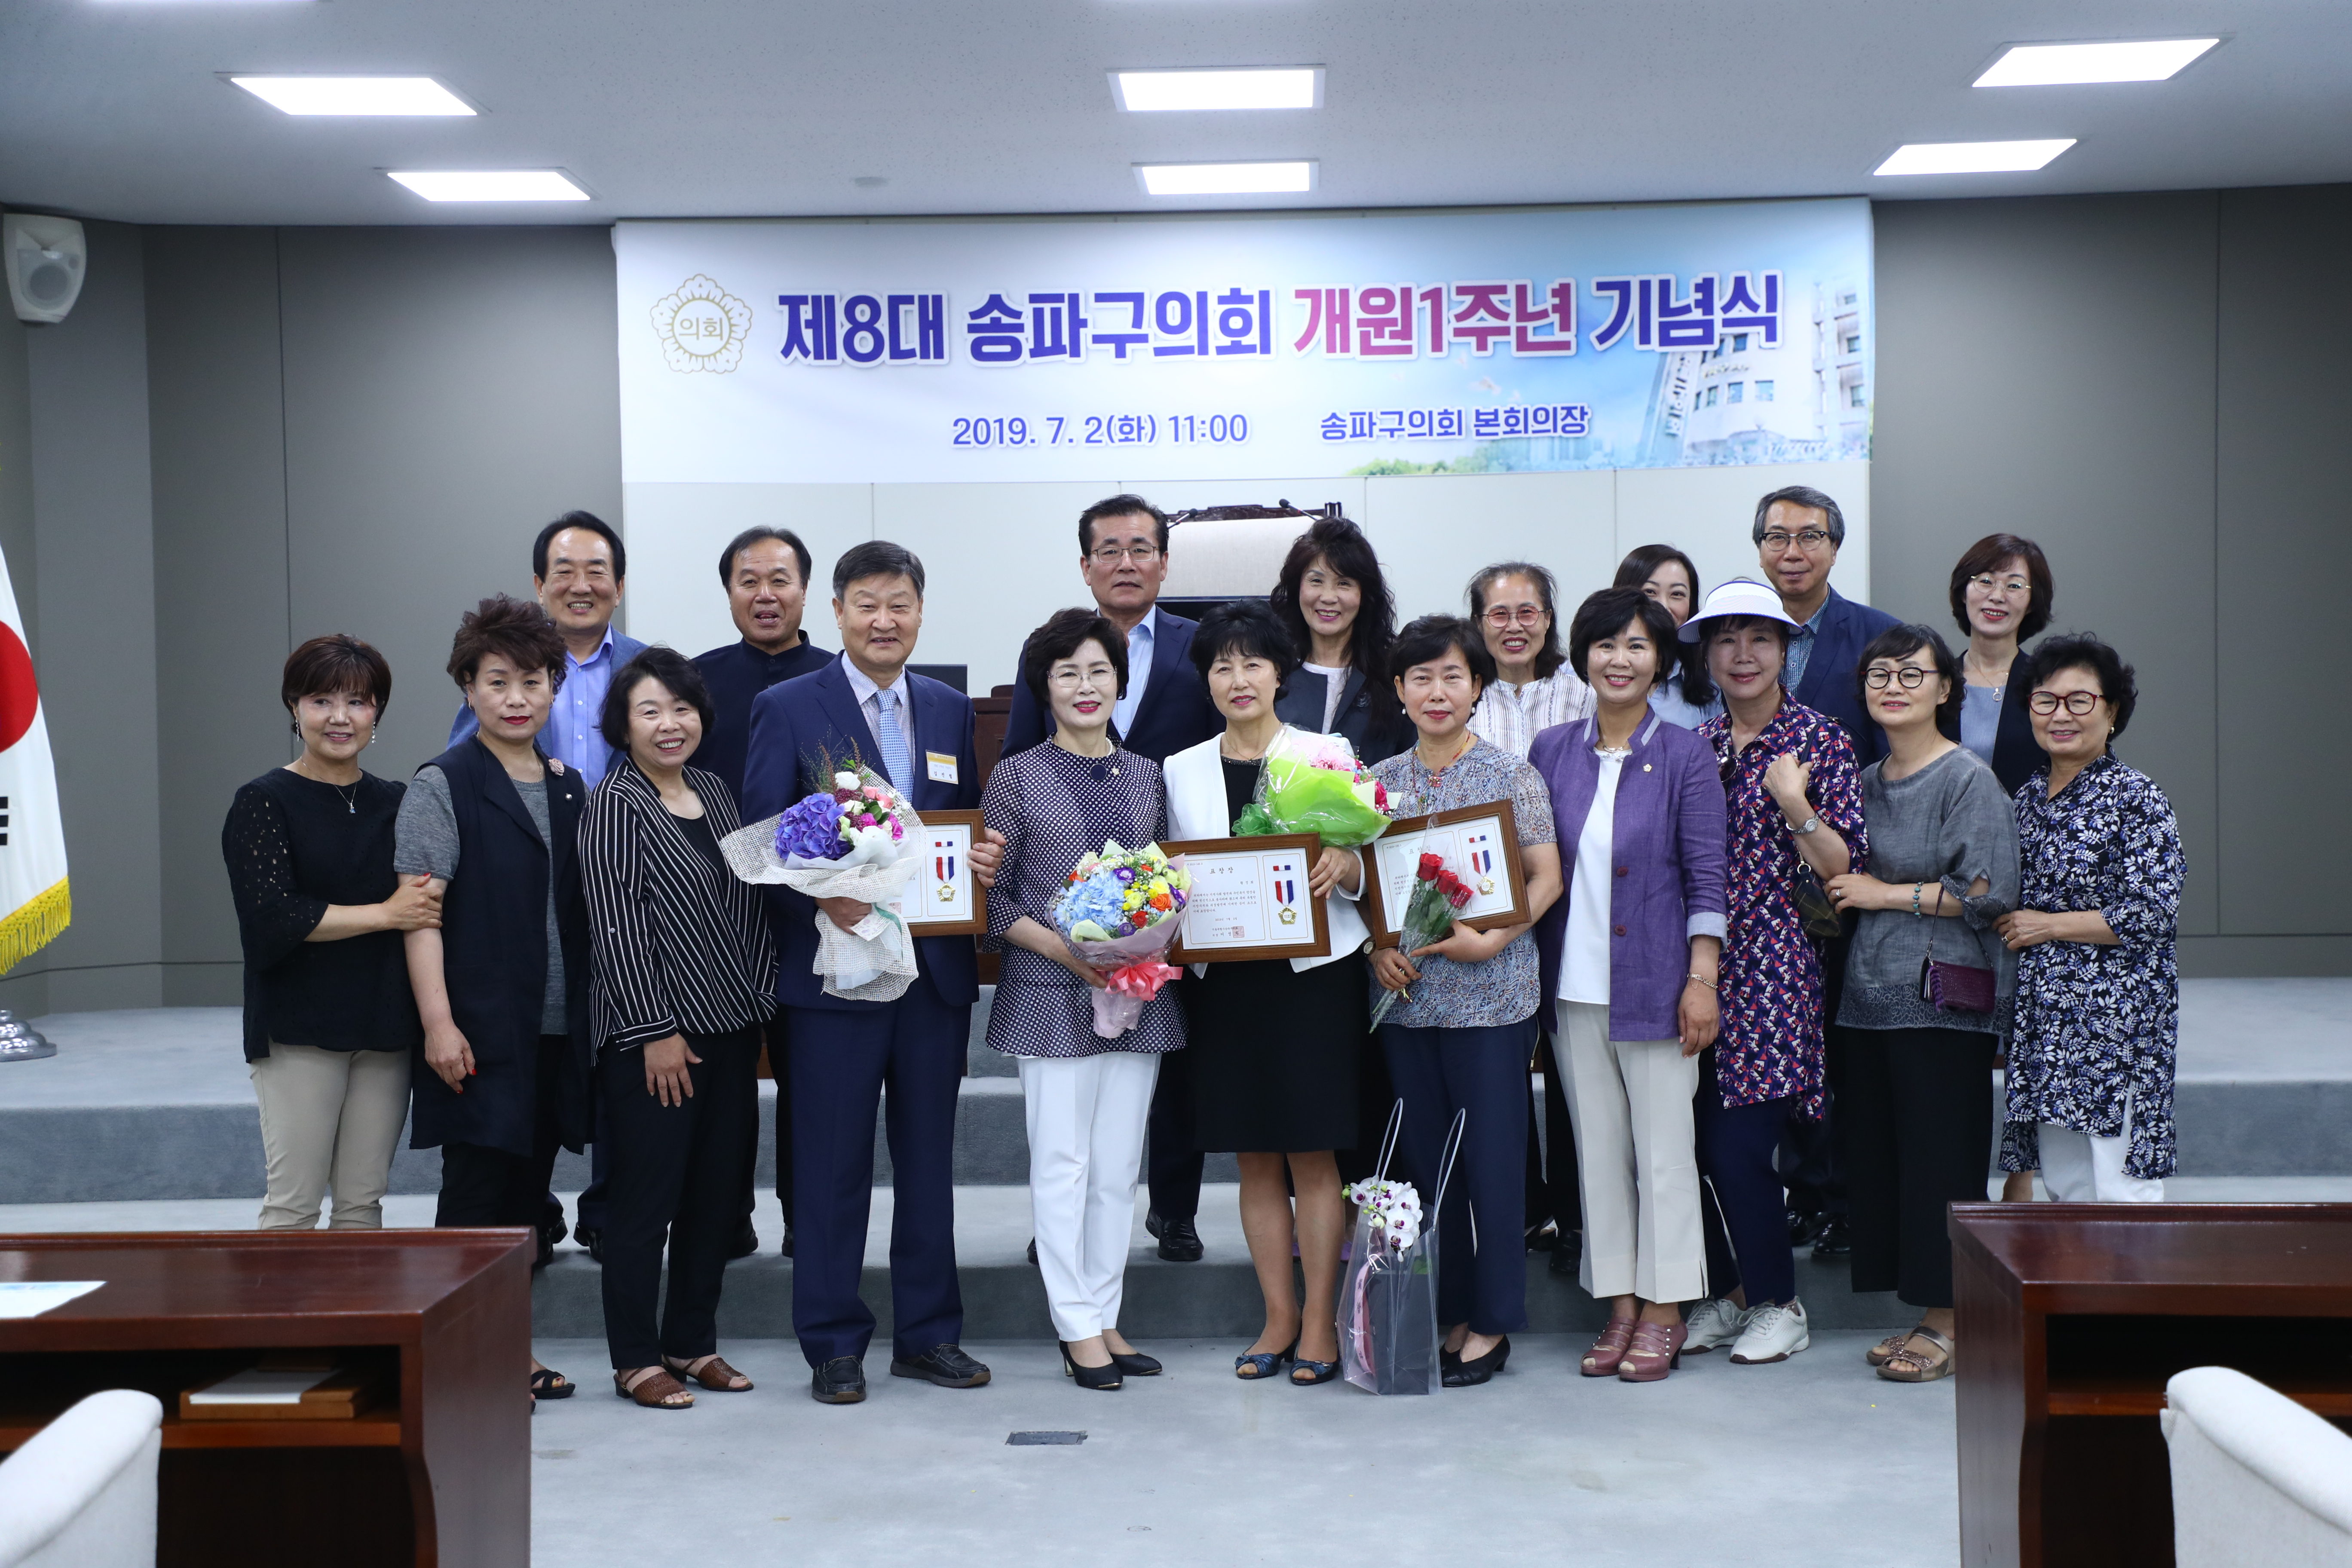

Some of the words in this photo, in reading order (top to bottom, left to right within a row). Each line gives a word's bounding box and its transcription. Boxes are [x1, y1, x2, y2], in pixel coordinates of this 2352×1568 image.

[679, 317, 723, 341] 의회
[778, 294, 944, 362] 제8대
[967, 287, 1271, 361] 송파구의회
[1294, 282, 1571, 355] 개원1주년
[1596, 275, 1777, 346] 기념식
[953, 417, 1035, 444] 2019.
[1047, 417, 1073, 444] 7.
[1084, 414, 1156, 444] 2(화)
[1168, 415, 1246, 442] 11:00
[1321, 408, 1462, 440] 송파구의회
[1474, 406, 1588, 437] 본회의장
